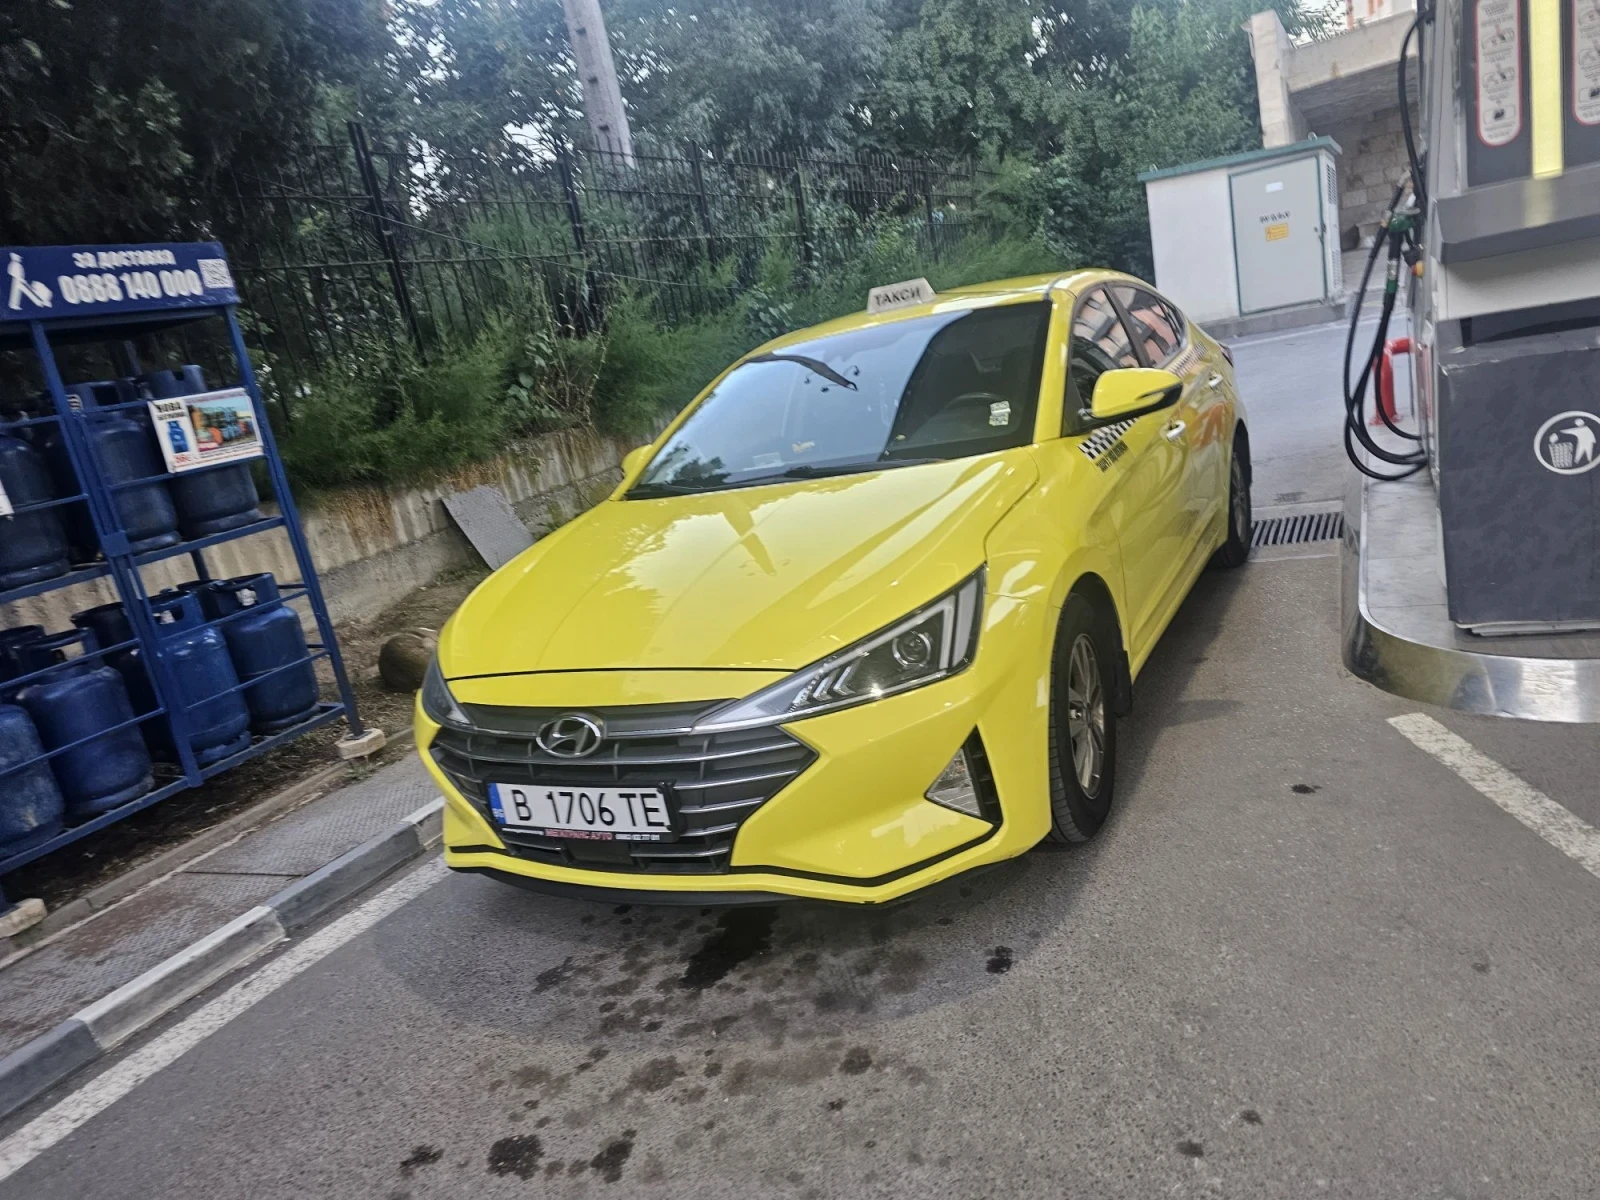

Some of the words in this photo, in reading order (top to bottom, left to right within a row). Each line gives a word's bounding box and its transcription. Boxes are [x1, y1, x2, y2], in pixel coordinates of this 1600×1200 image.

[57, 272, 124, 305] 0888
[119, 271, 163, 300] 140
[159, 268, 204, 298] 000
[873, 286, 921, 307] ТАКСИ
[511, 789, 532, 822] B
[546, 791, 615, 826] 1706
[617, 793, 665, 827] TE
